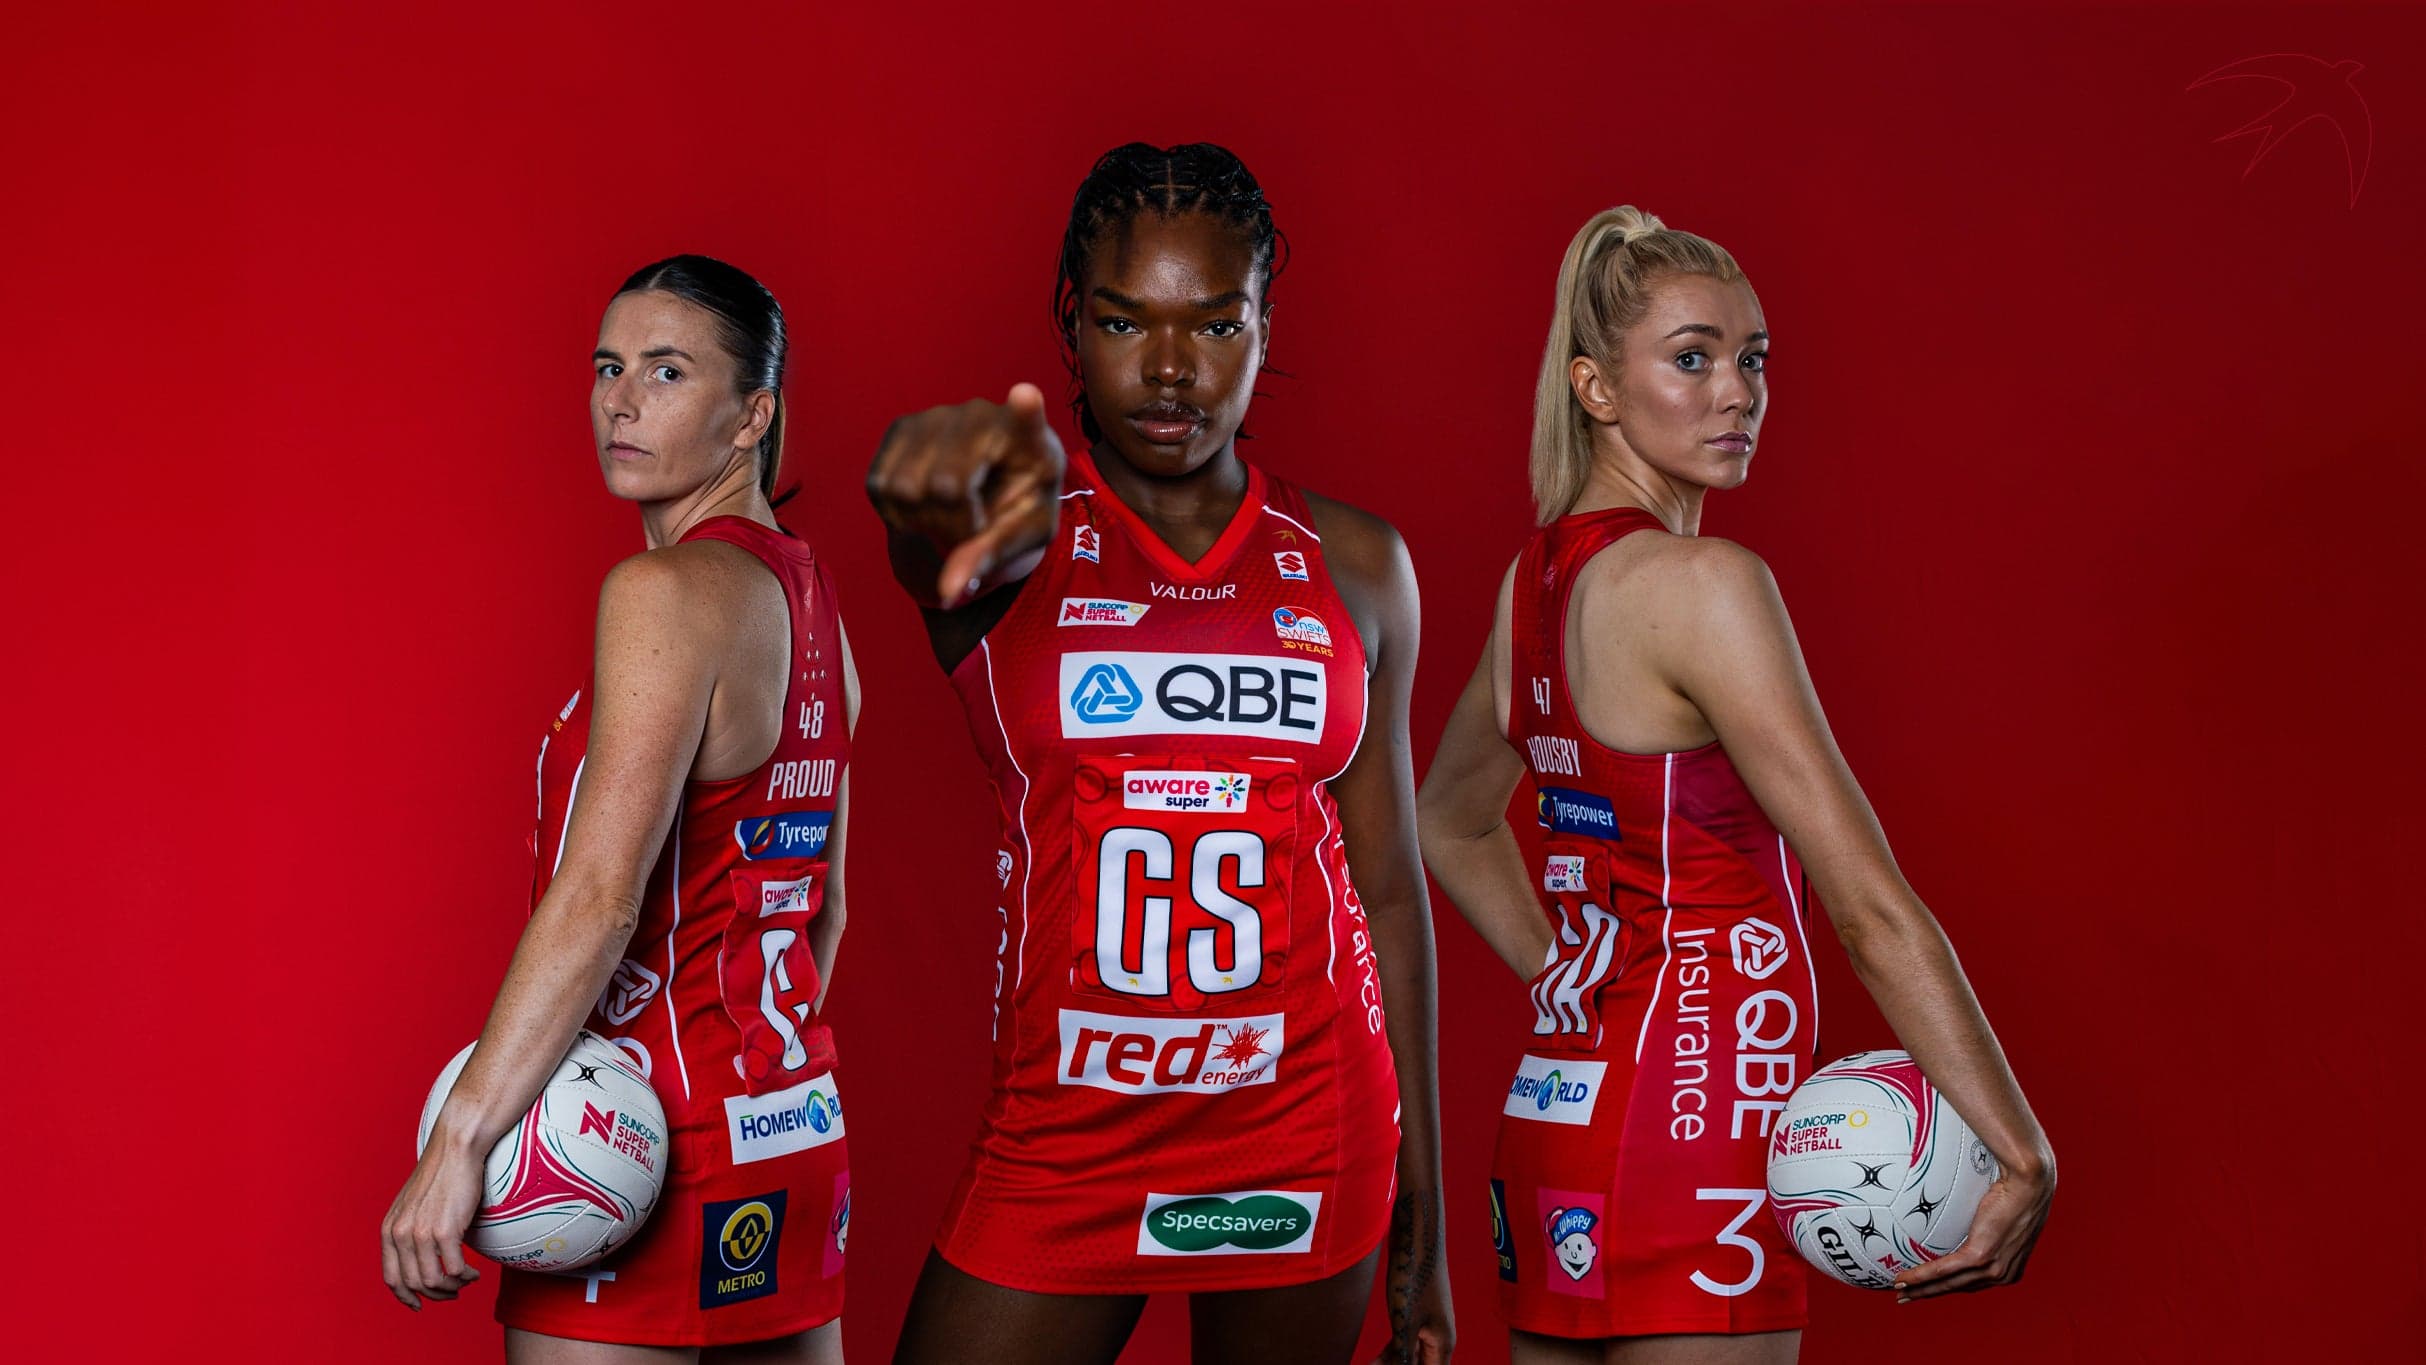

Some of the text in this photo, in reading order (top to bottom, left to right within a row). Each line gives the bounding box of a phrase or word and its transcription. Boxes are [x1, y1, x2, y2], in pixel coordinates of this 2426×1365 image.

[1151, 581, 1236, 600] VALOUR
[1088, 602, 1128, 610] SUNCORP
[1278, 628, 1331, 644] SWIFTS
[1299, 622, 1324, 634] nsw
[1296, 642, 1334, 657] YEARS
[1156, 664, 1318, 731] QBE
[1532, 677, 1550, 715] 47
[799, 700, 824, 739] 48
[767, 759, 836, 801] PROUD
[1127, 779, 1210, 795] aware
[1165, 797, 1210, 810] super
[1553, 796, 1613, 827] Tyrepower
[1095, 826, 1266, 995] GS
[1670, 927, 1716, 1141] Insurance
[1067, 1024, 1216, 1087] red
[1730, 989, 1798, 1140] QBE
[1201, 1065, 1268, 1085] energy
[618, 1113, 660, 1146] SUNCORP
[1791, 1126, 1828, 1143] SUPER
[1792, 1113, 1846, 1131] SUNCORP
[616, 1125, 650, 1154] SUPER
[1790, 1138, 1842, 1156] NETBALL
[612, 1137, 655, 1174] NETBALL
[1161, 1209, 1298, 1233] Specsavers
[1559, 1214, 1591, 1235] Whippy
[1690, 1188, 1767, 1297] 3
[717, 1270, 766, 1295] METRO
